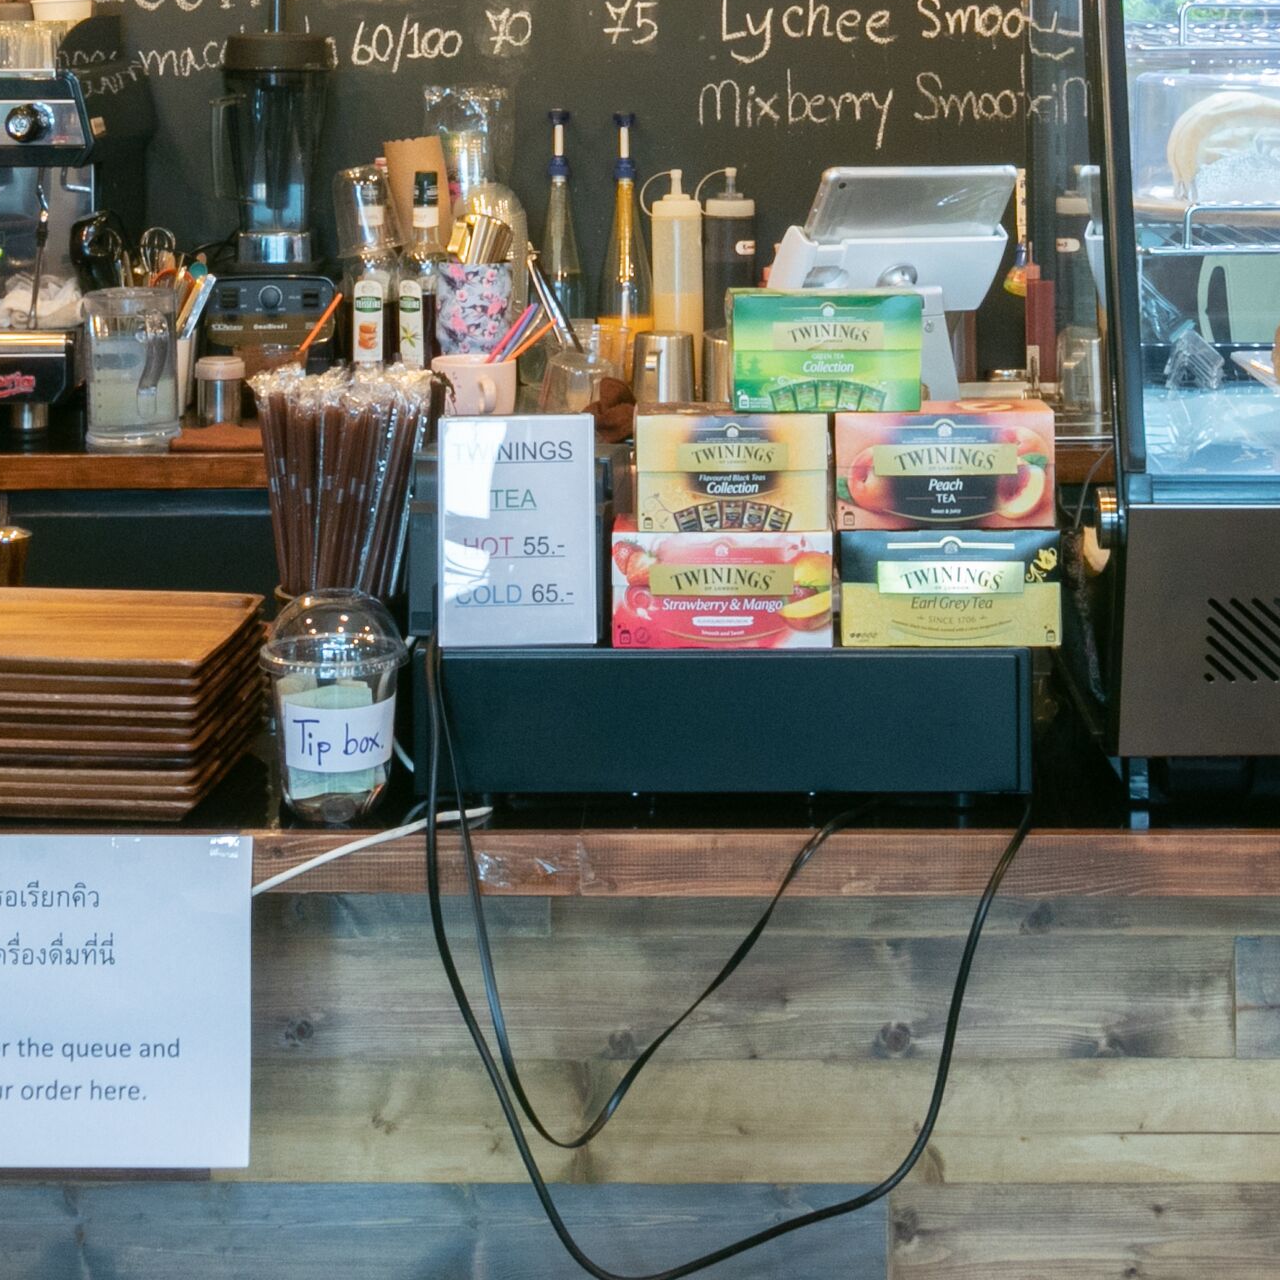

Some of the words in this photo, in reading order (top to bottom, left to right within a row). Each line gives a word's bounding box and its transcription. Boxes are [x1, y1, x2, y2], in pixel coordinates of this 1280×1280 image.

[351, 17, 463, 74] 60/100
[489, 11, 532, 48] 70
[605, 2, 658, 46] 75
[787, 323, 870, 343] TWININGS
[802, 361, 855, 373] Collection
[454, 441, 573, 460] TWNINGS
[691, 445, 773, 464] TWININGS
[894, 446, 995, 471] TWININGS
[706, 482, 759, 495] Collection
[928, 478, 963, 492] Peach
[490, 488, 537, 508] TEA
[936, 493, 956, 504] TEA
[523, 536, 565, 556] 55.-
[671, 568, 772, 590] TWININGS
[900, 567, 1002, 590] TWININGS
[532, 584, 573, 603] 65.-
[662, 599, 728, 613] Strawberry
[730, 599, 740, 609] &
[742, 599, 783, 612] Mango
[911, 597, 936, 609] Earl
[939, 597, 969, 612] Grey
[972, 597, 993, 609] Tea
[292, 719, 332, 766] Tip
[18, 1037, 54, 1058] the
[62, 1043, 132, 1068] queue
[139, 1038, 181, 1058] and
[20, 1080, 82, 1101] order
[89, 1080, 148, 1101] here.
